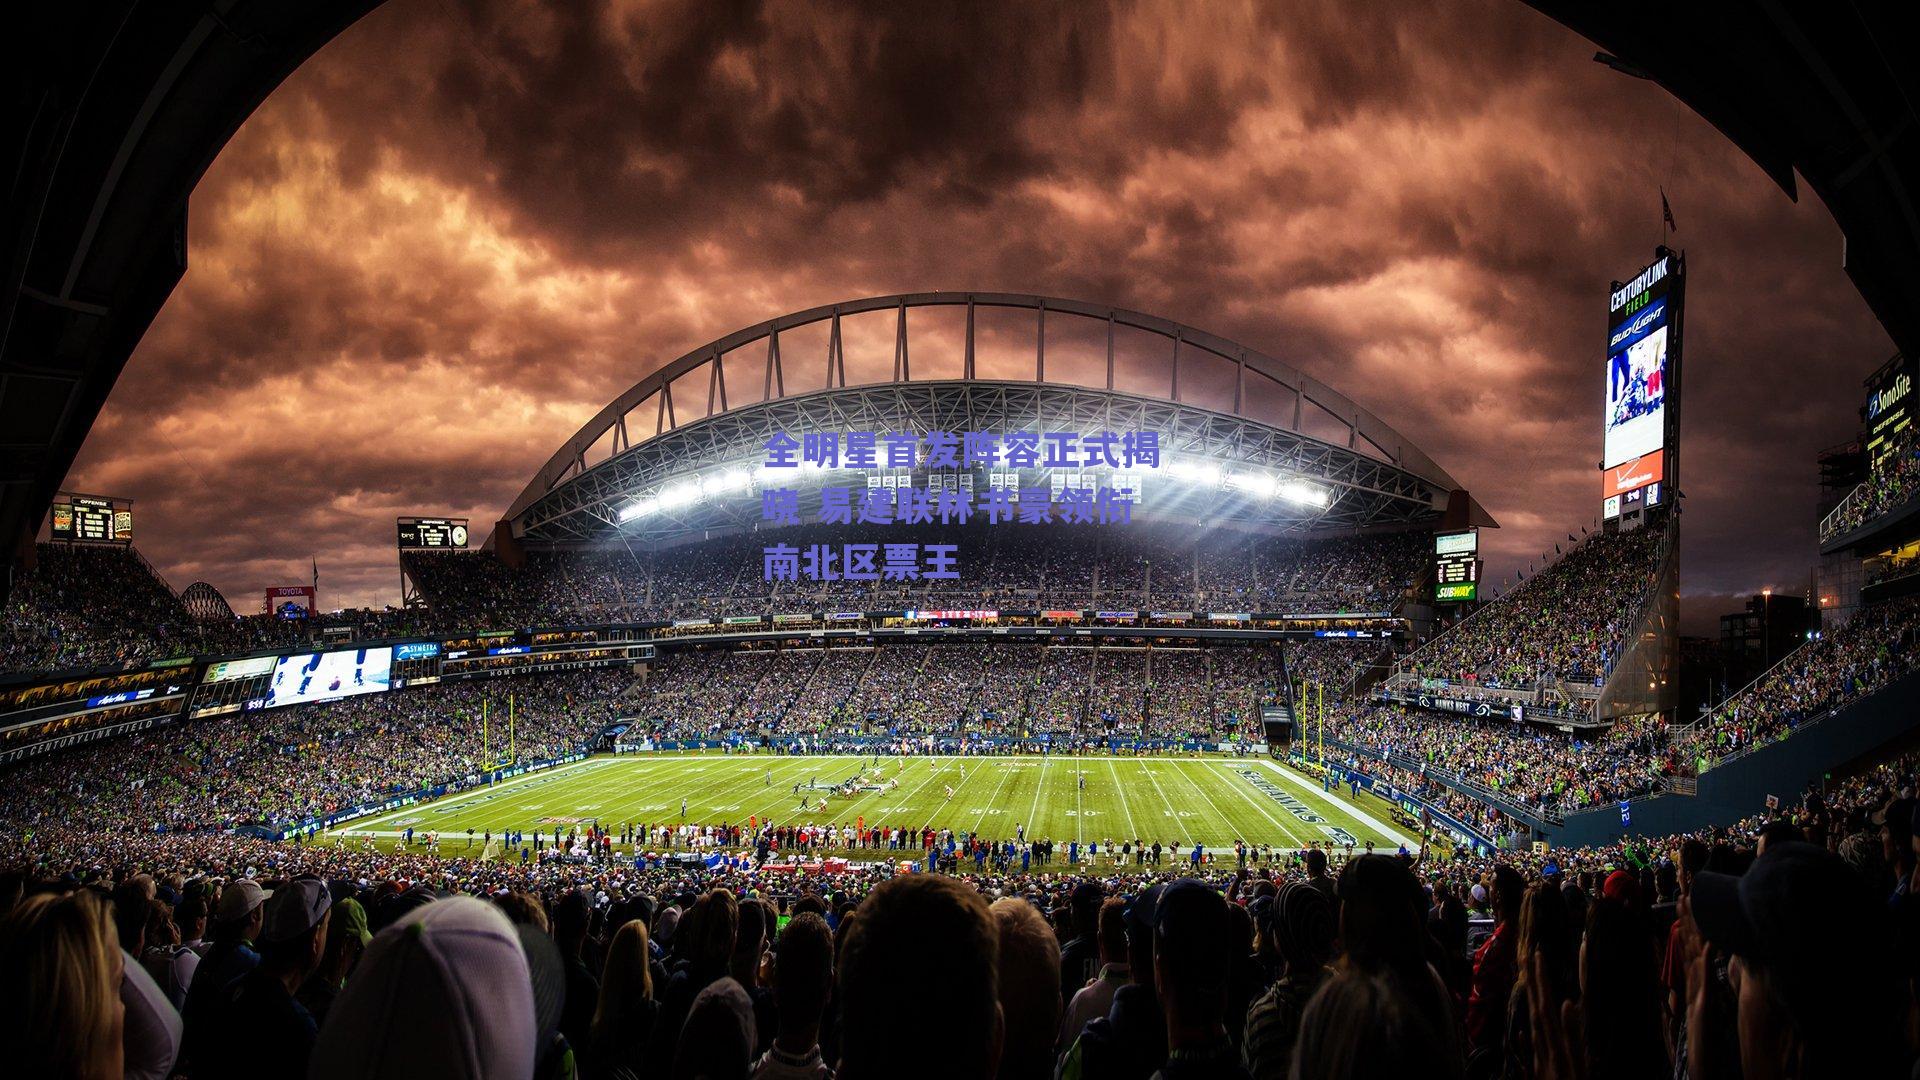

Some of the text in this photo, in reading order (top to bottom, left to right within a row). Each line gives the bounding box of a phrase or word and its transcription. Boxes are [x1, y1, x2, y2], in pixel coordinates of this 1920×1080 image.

[1610, 256, 1668, 313] CENTURYLINK
[1625, 290, 1650, 316] FIELD
[1610, 305, 1665, 347] BUD LIGHT
[1878, 373, 1911, 414] SonoSite
[80, 499, 107, 507] OFFENSE
[278, 587, 304, 596] TOYOTA
[1437, 585, 1474, 599] SUBWAY
[410, 644, 438, 652] SYMETRA
[489, 660, 609, 677] HOME OF THE 12TH MAN
[9, 749, 24, 762] TO
[30, 728, 112, 756] CENTURYLINK
[118, 720, 153, 735] FIELD
[1234, 769, 1328, 823] SEAHAWKS
